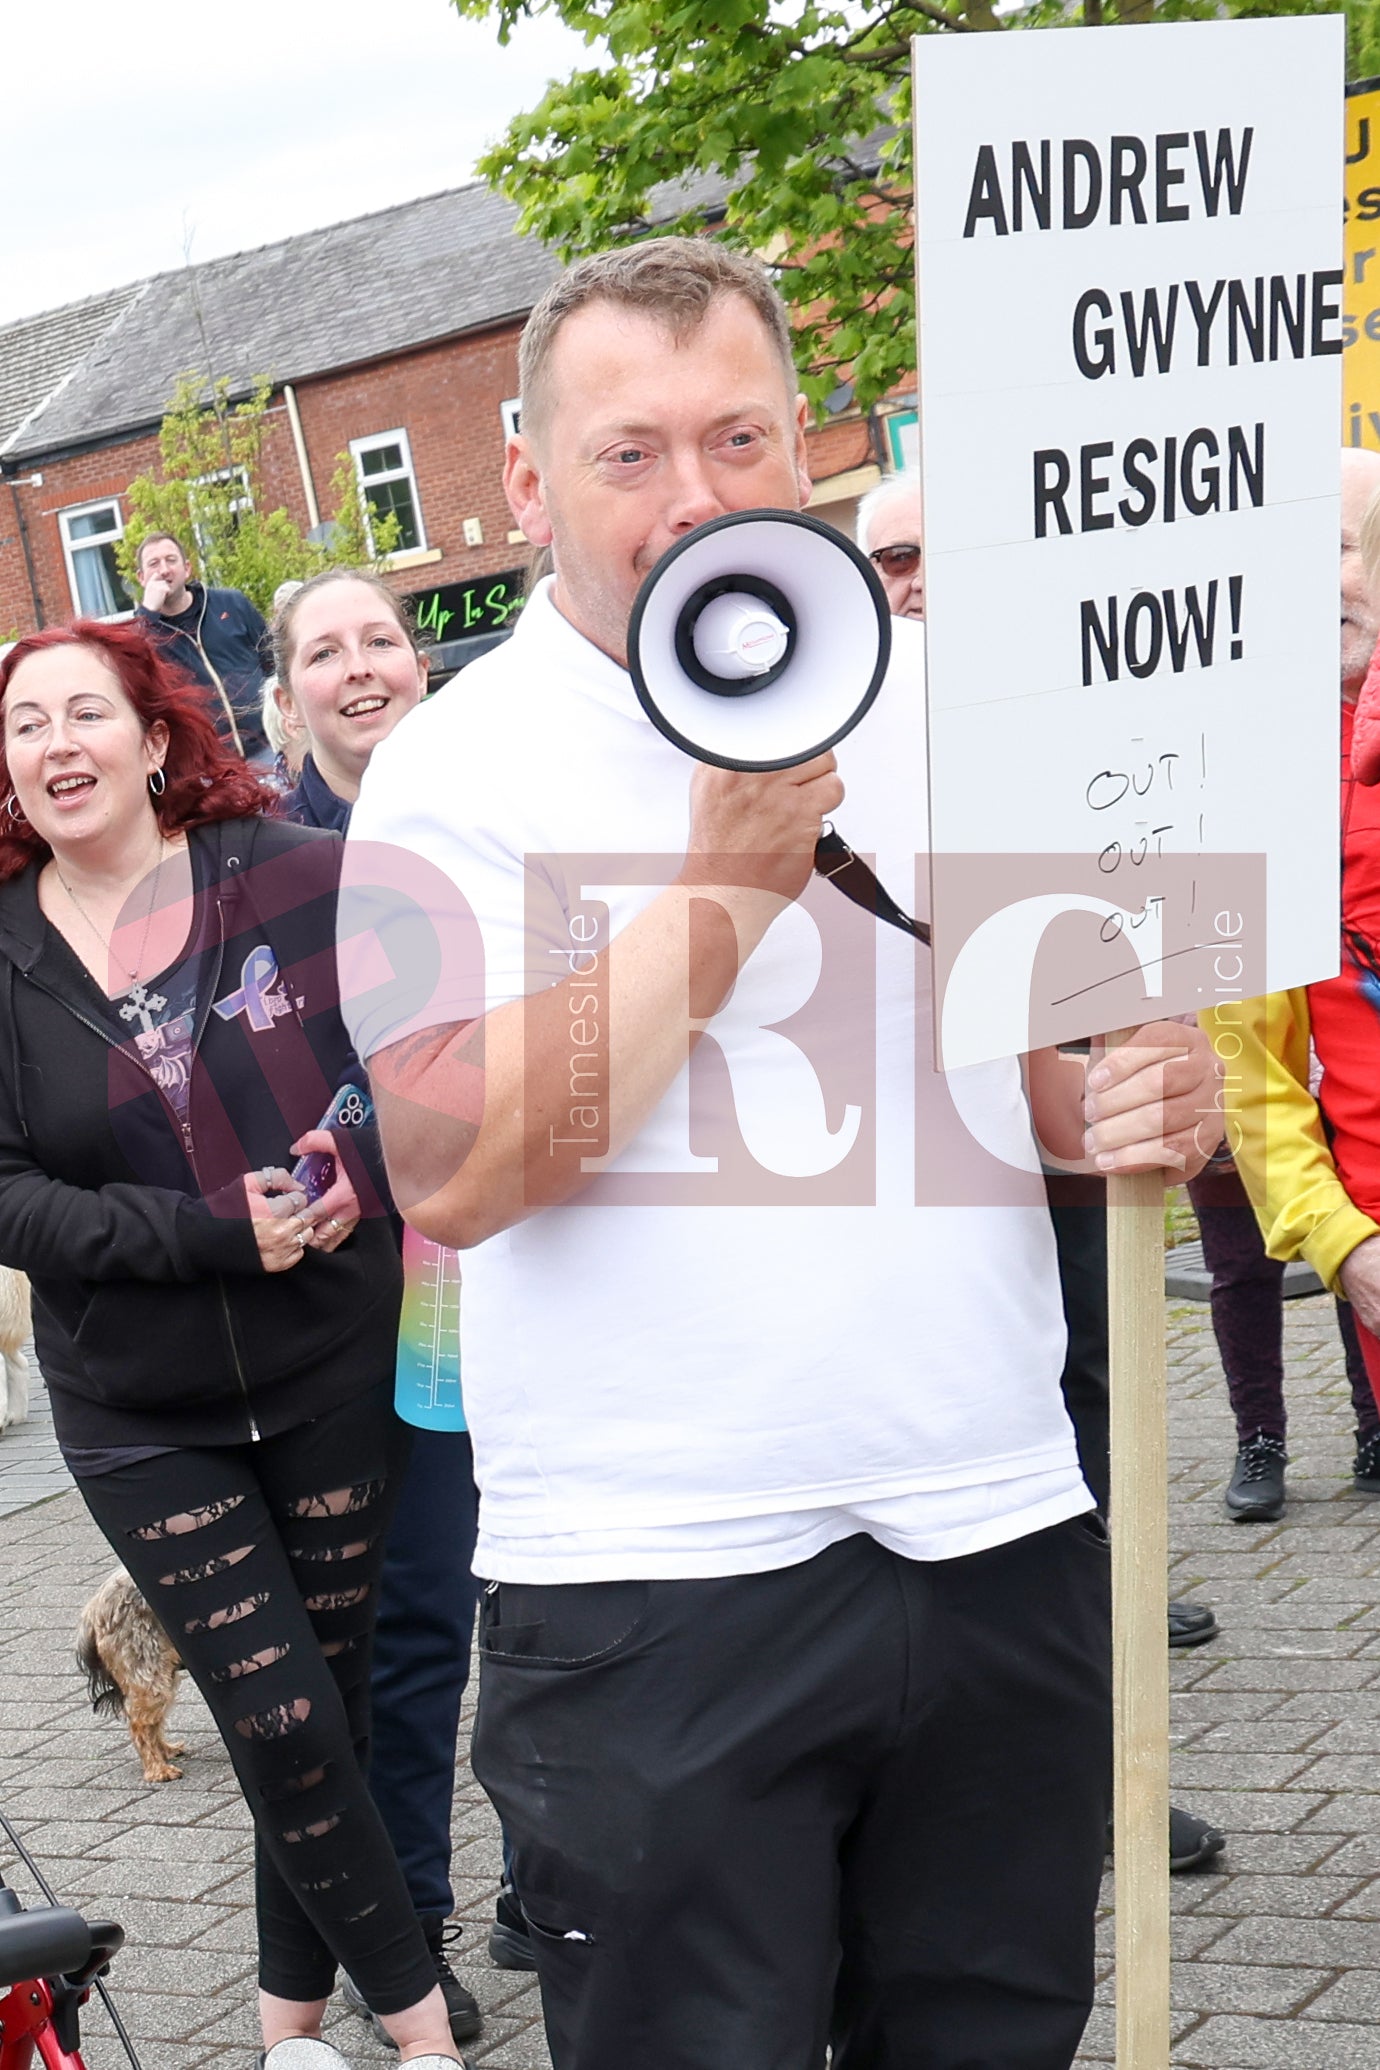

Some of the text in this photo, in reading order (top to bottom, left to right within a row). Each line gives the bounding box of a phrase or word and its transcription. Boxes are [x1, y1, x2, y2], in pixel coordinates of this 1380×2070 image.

[964, 127, 1253, 238] ANDREW
[1073, 269, 1342, 380] GWYNNE
[1034, 422, 1264, 539] RESIGN
[417, 592, 455, 641] Up
[463, 589, 484, 628] In
[1081, 575, 1243, 687] NOW!
